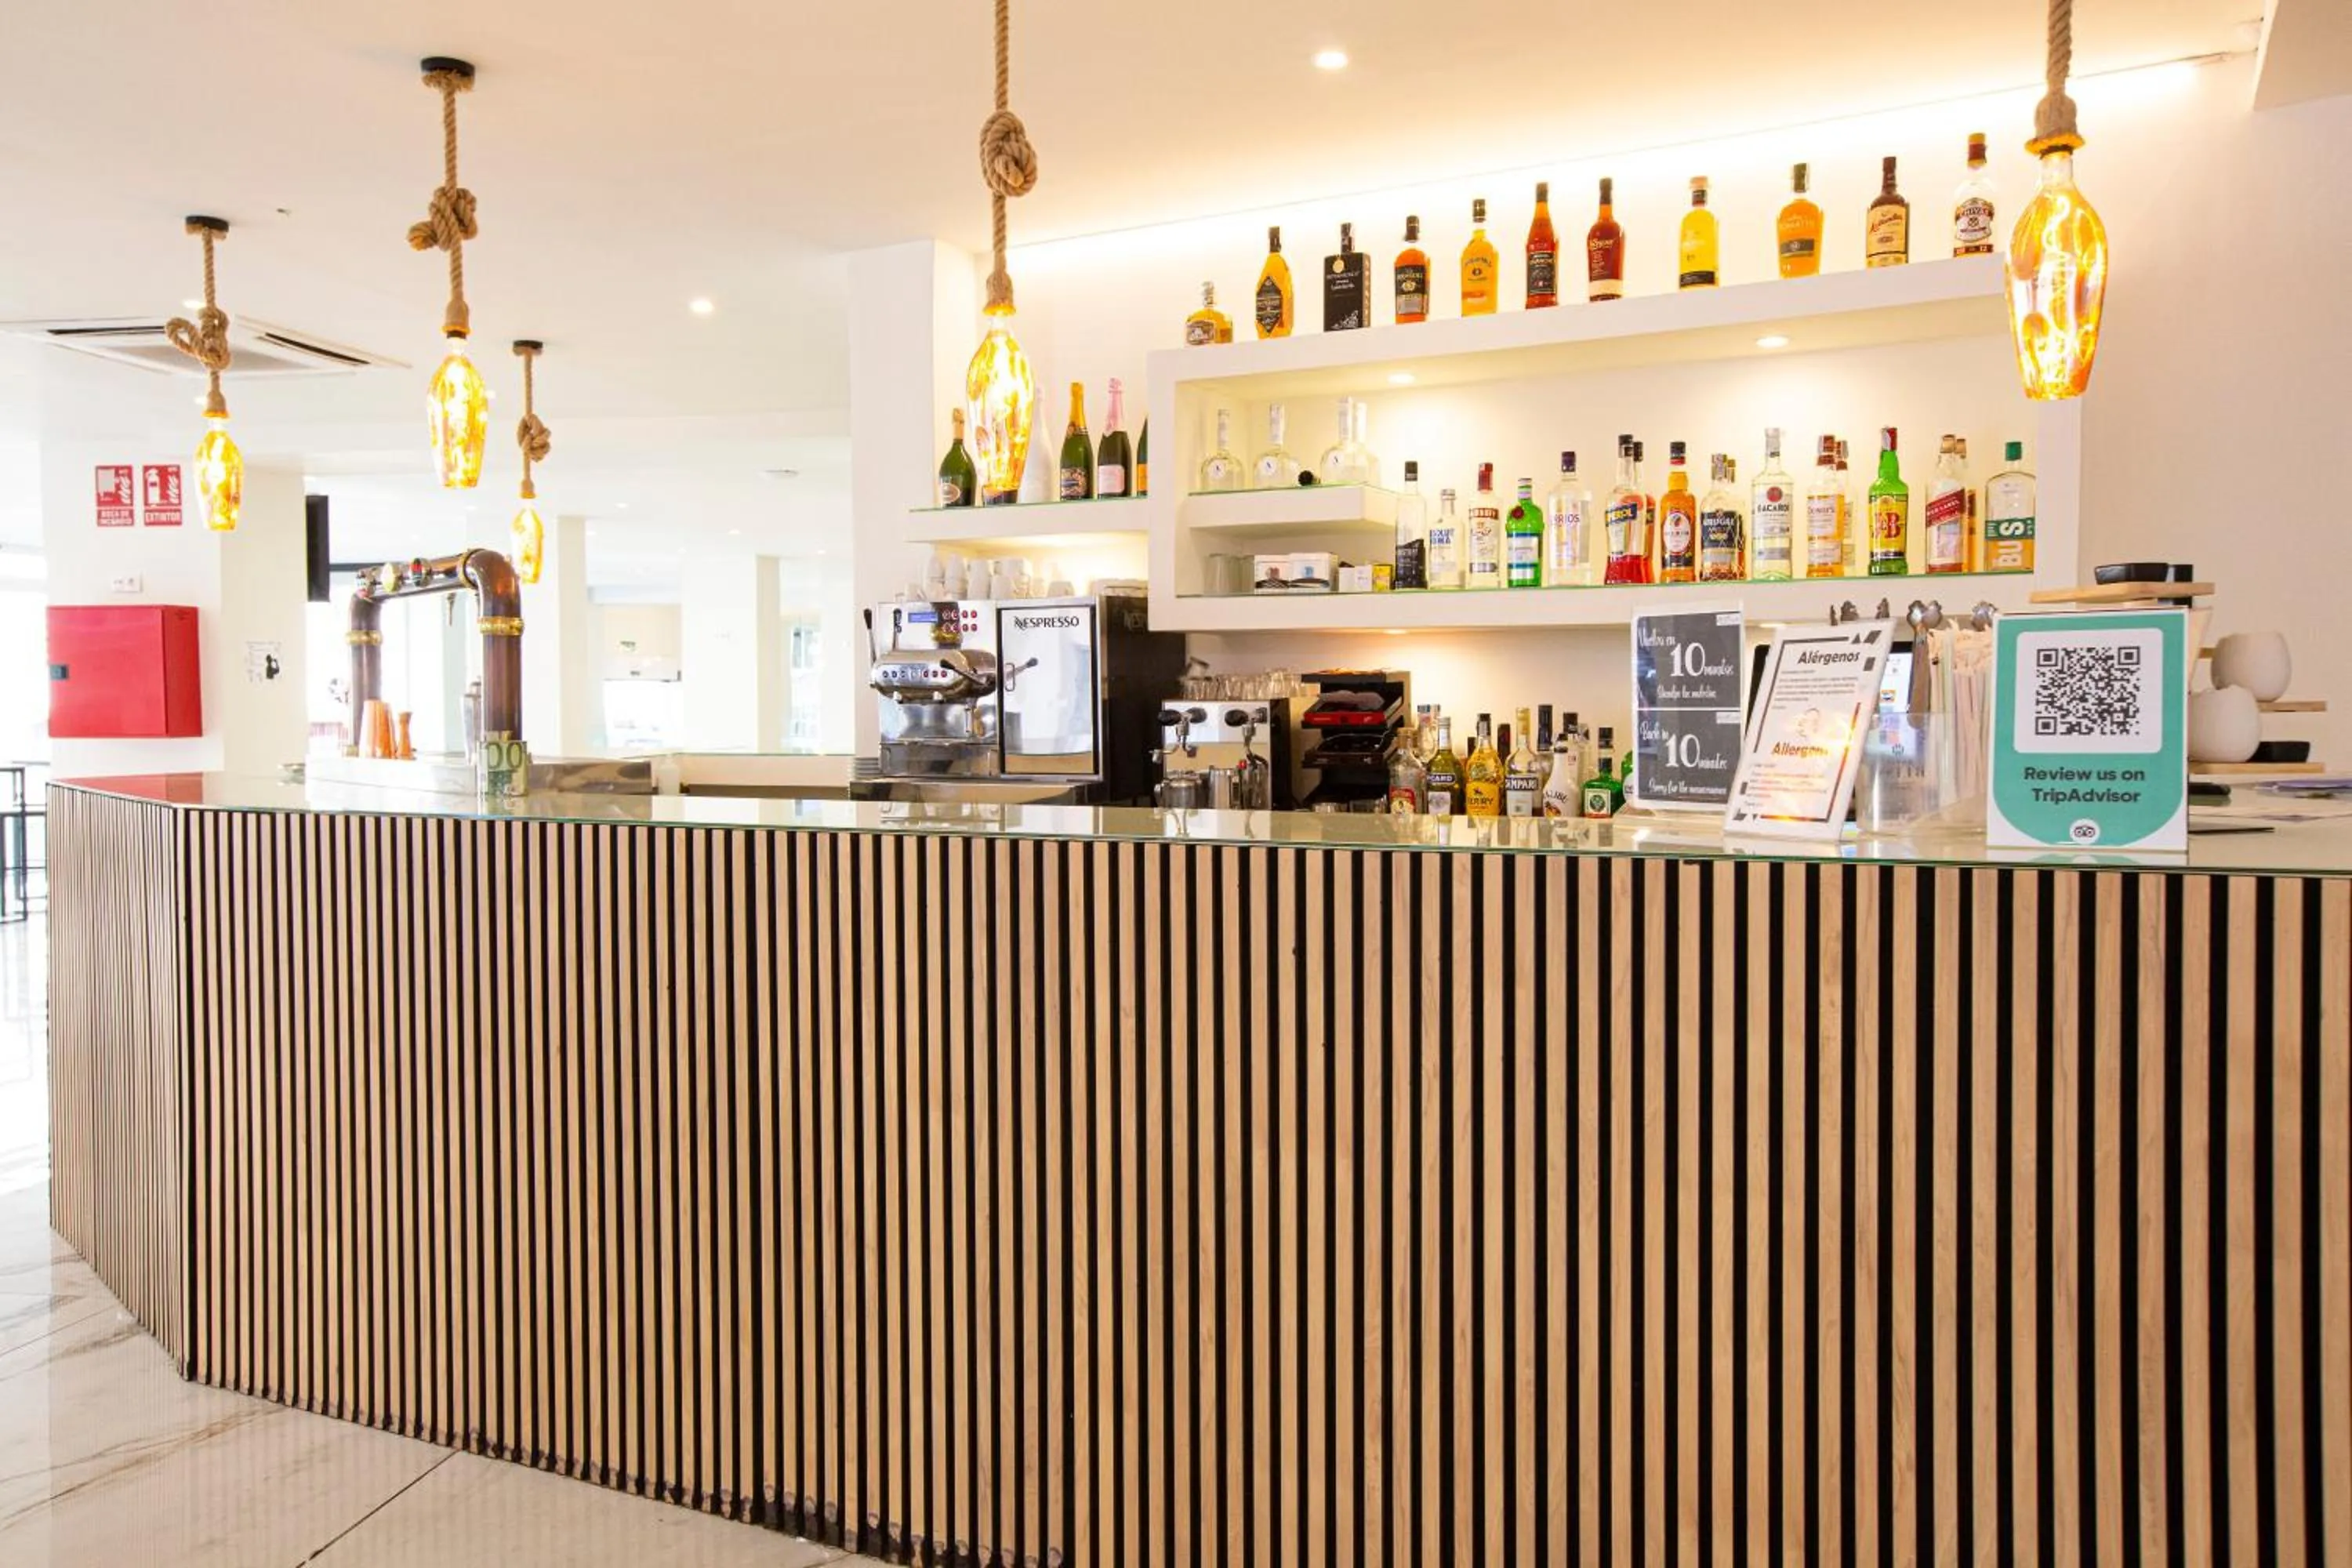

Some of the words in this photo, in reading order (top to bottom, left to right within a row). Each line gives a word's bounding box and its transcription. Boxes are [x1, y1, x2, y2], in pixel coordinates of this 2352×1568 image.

[1014, 615, 1080, 630] NESPRESSO
[1670, 642, 1705, 677] 10
[1798, 650, 1860, 666] Alérgenos
[1665, 734, 1700, 768] 10
[2024, 766, 2092, 781] Review
[2096, 770, 2116, 781] us
[2121, 769, 2145, 781] on
[2032, 788, 2141, 805] TripAdvisor
